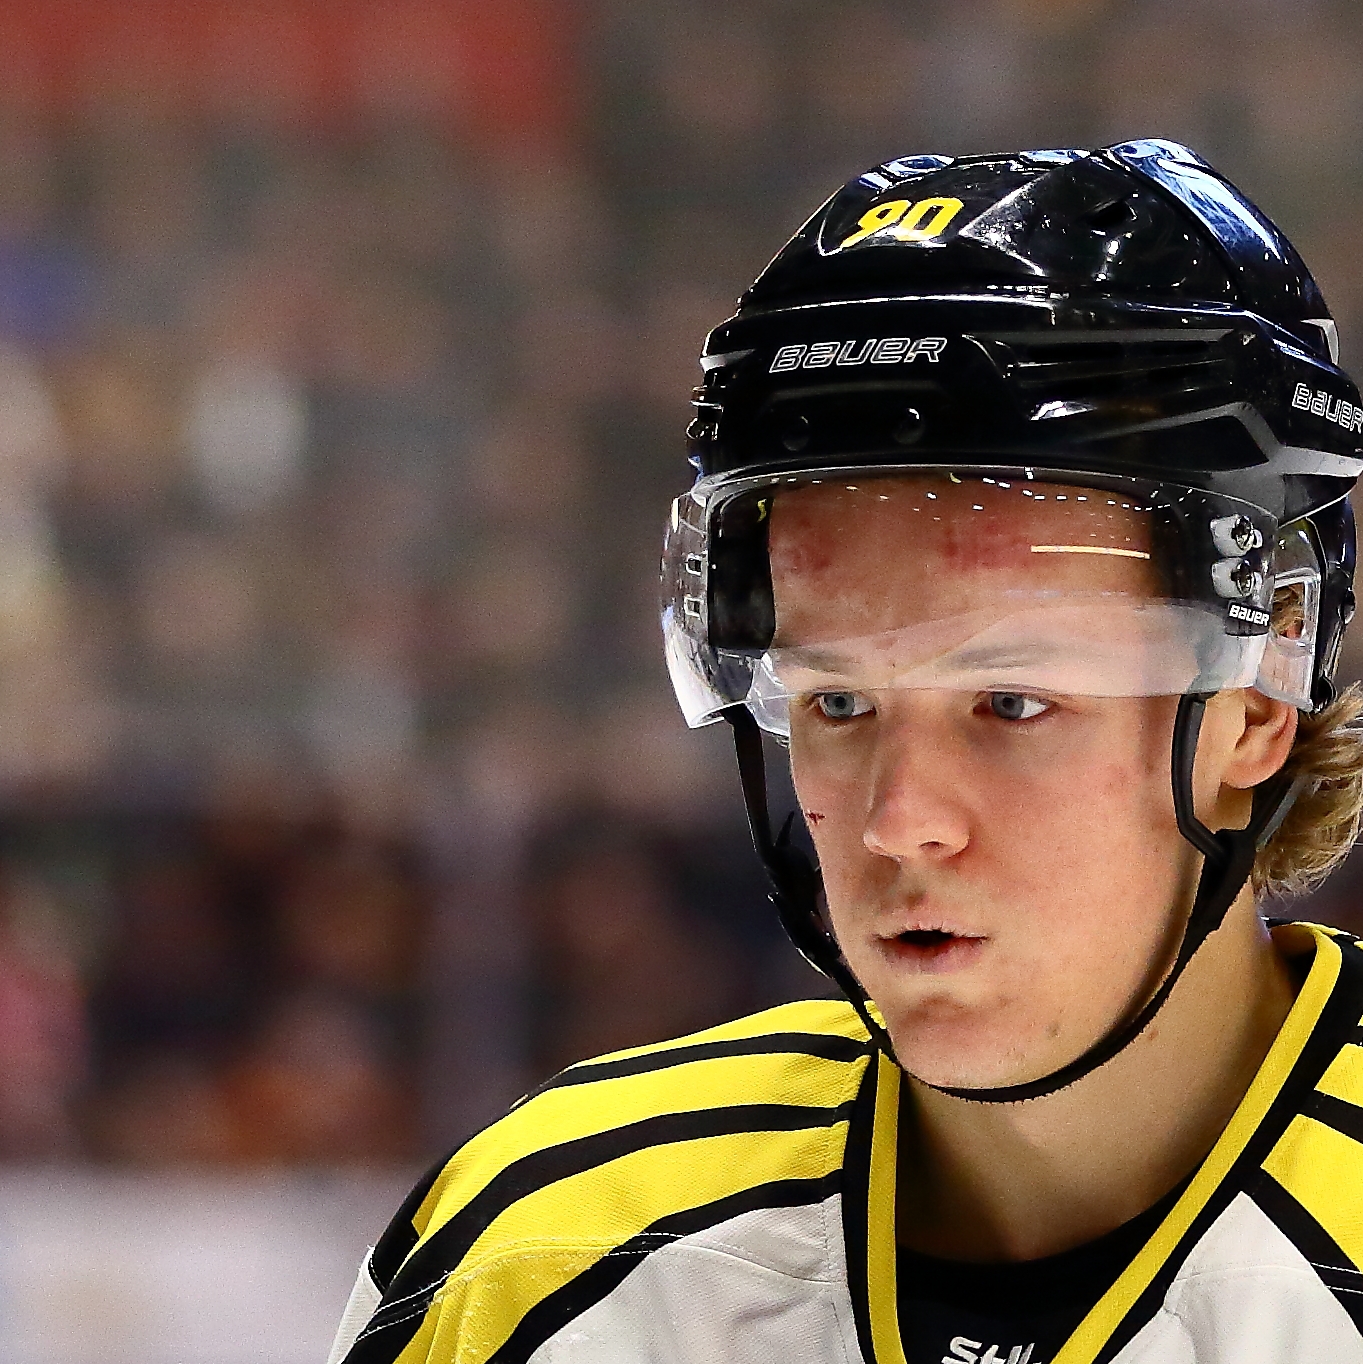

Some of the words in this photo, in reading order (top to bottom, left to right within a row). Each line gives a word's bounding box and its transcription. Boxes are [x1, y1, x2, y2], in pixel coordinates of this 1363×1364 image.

[840, 197, 965, 249] 90
[768, 336, 948, 374] BAUER
[1228, 603, 1271, 627] BAUER
